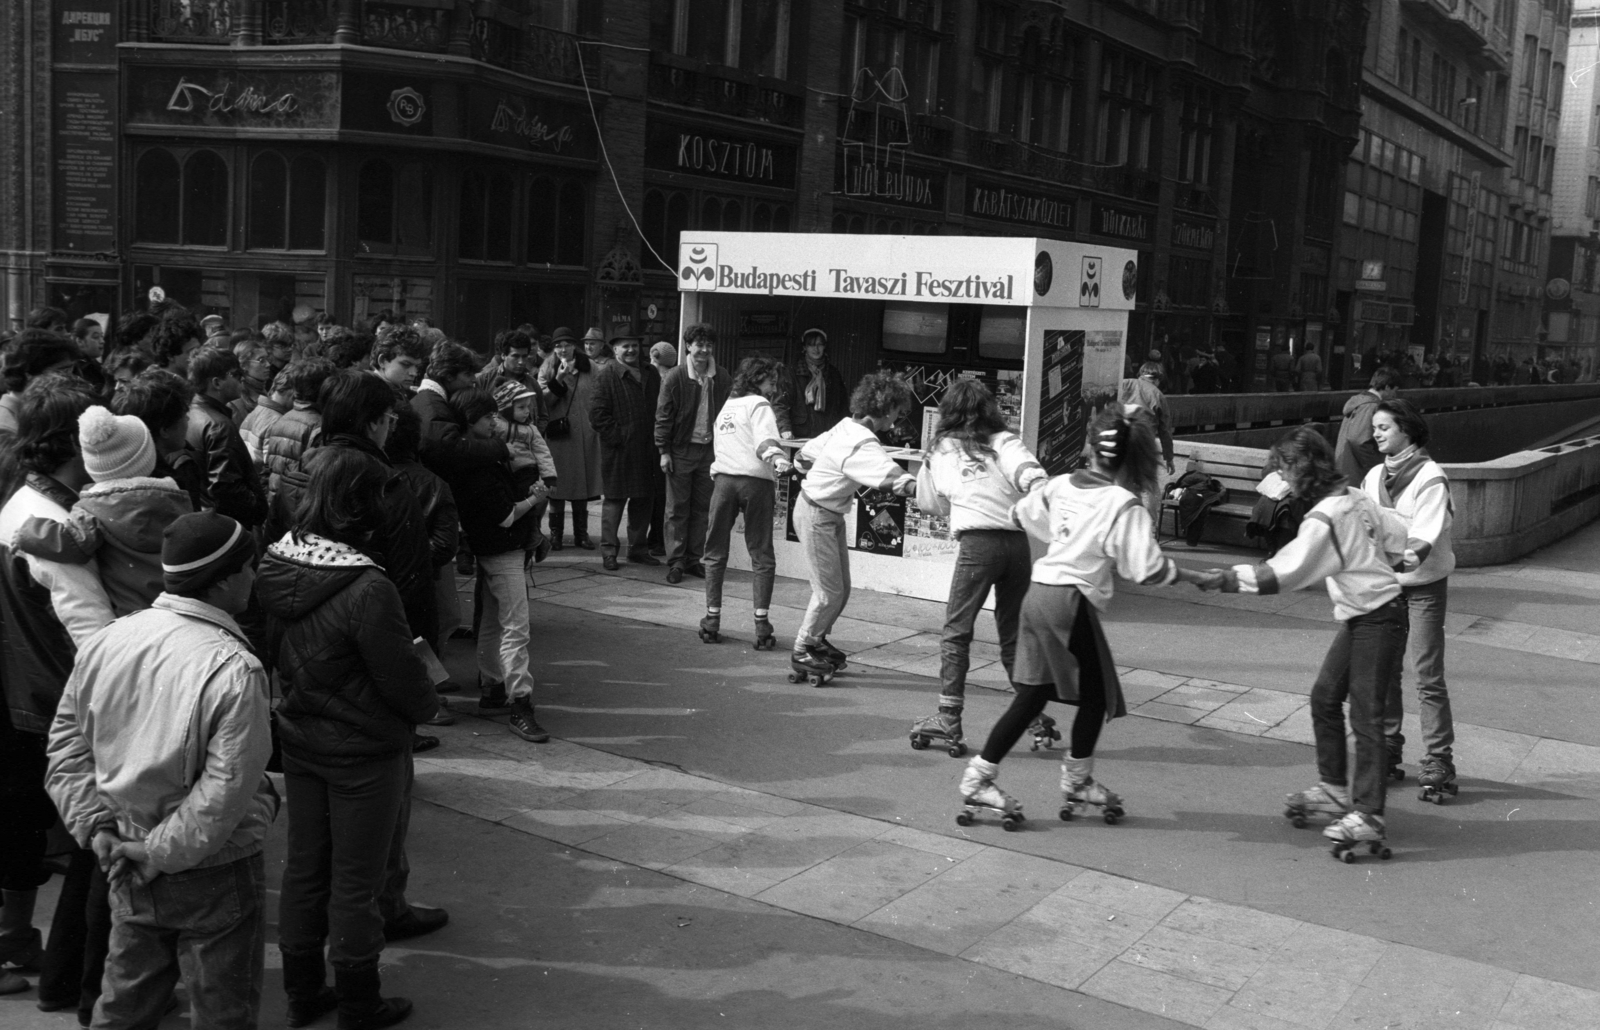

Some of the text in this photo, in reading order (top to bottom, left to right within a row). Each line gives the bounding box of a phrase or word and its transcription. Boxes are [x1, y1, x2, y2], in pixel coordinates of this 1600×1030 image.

[885, 171, 933, 204] BUNDA
[717, 264, 1014, 300] Budapesti Tavaszi Fesztivál
[612, 312, 632, 323] DÁMA
